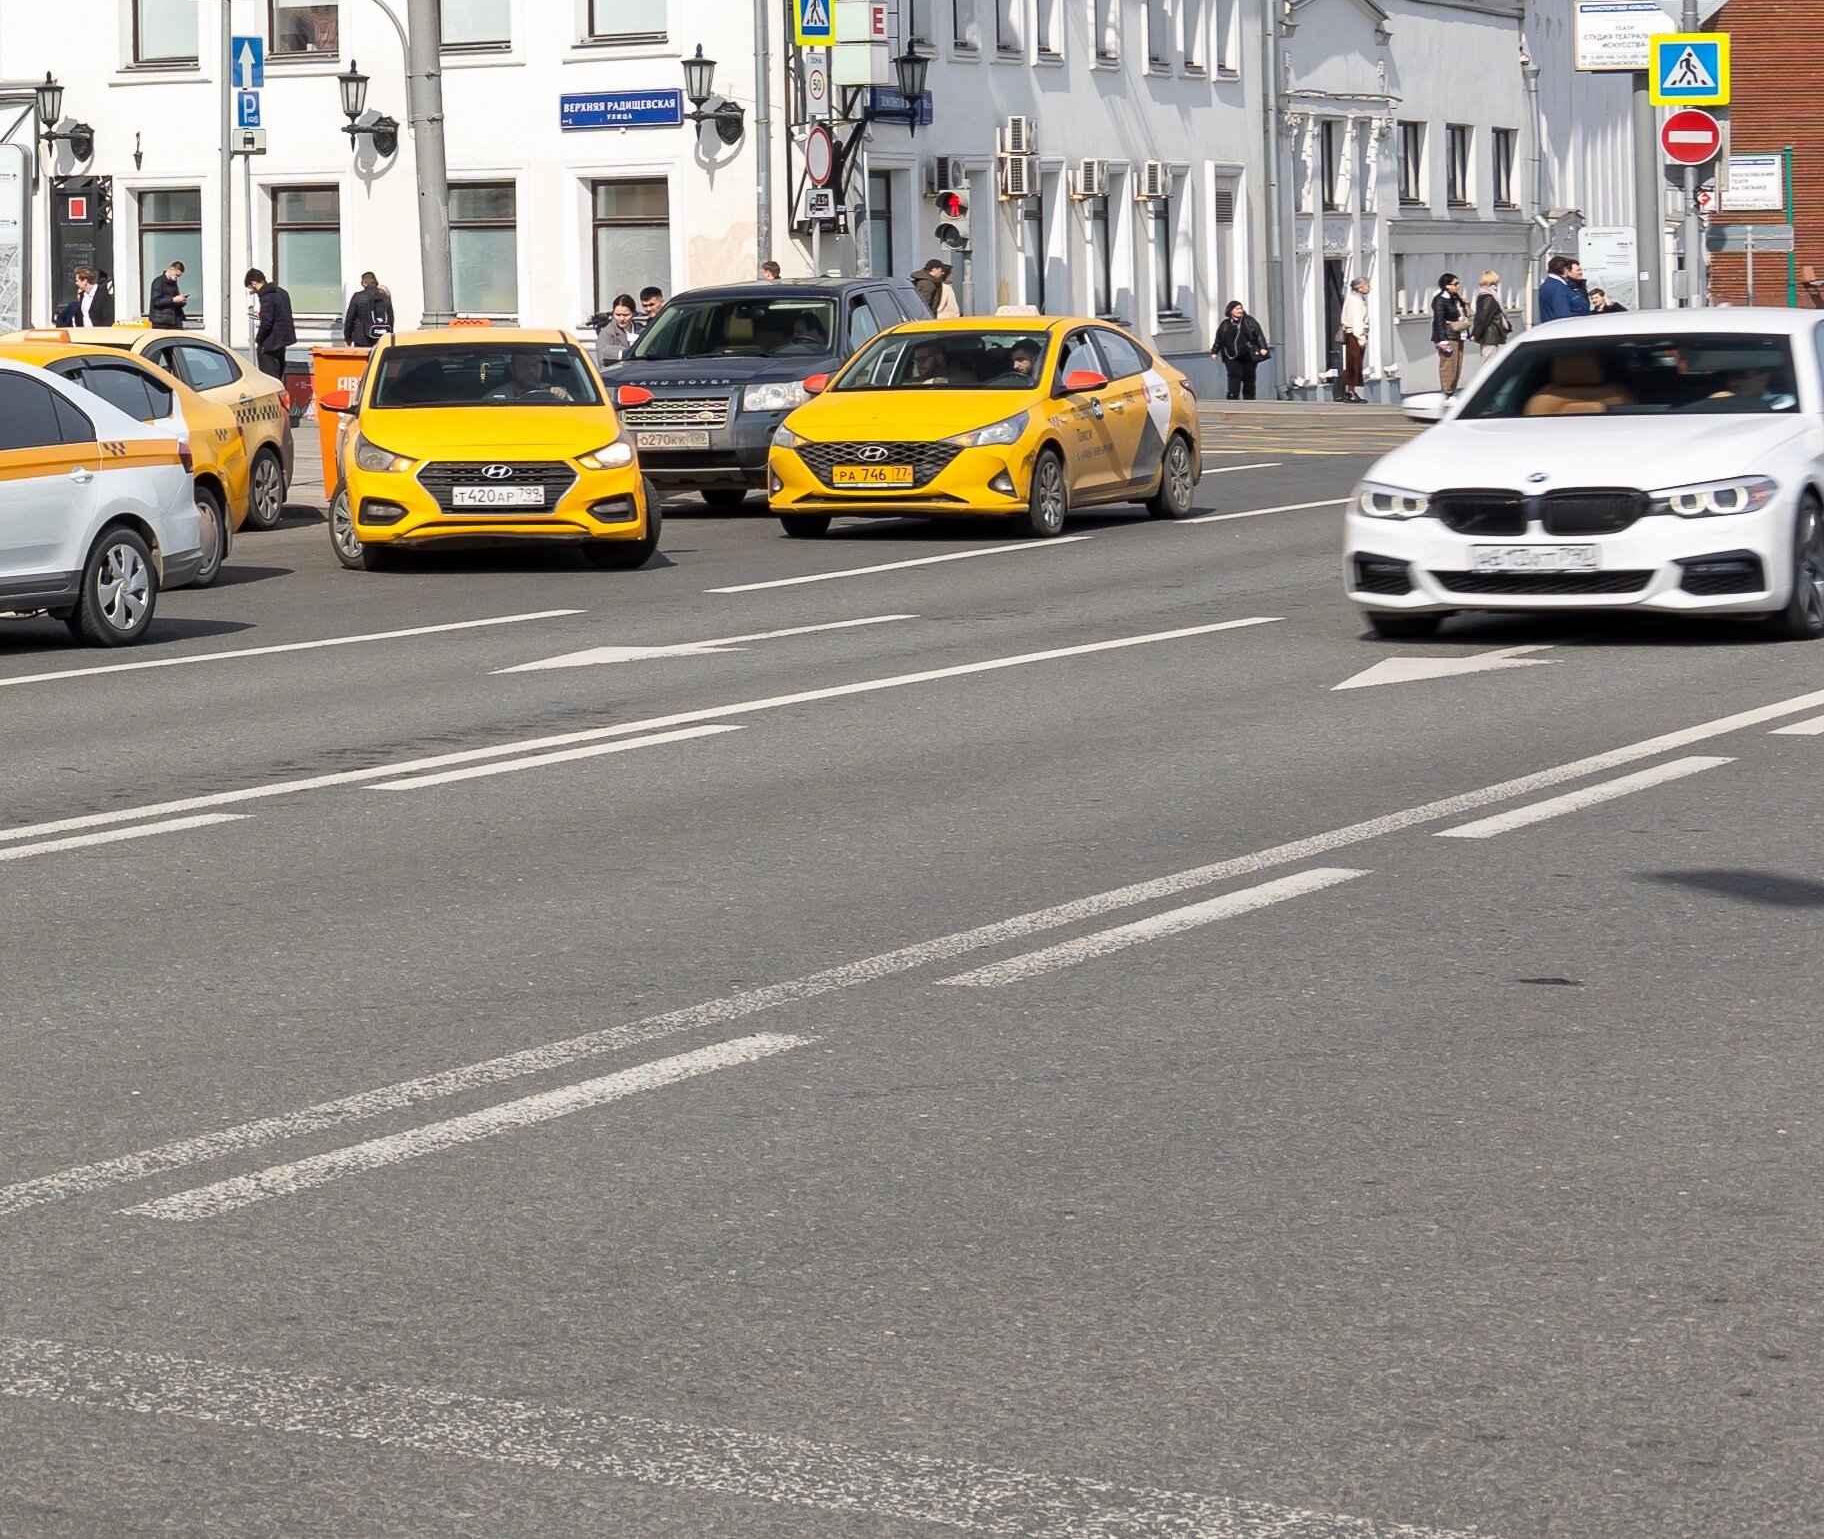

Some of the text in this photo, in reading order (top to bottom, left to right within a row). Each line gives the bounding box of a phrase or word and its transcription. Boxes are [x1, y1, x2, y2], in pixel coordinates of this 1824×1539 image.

[813, 78, 822, 92] 50
[563, 98, 676, 113] ВЕРХНЯЯ РАДИЩЕВСКАЯ
[839, 467, 908, 482] РА 746 77
[458, 487, 540, 503] Т420АР 799
